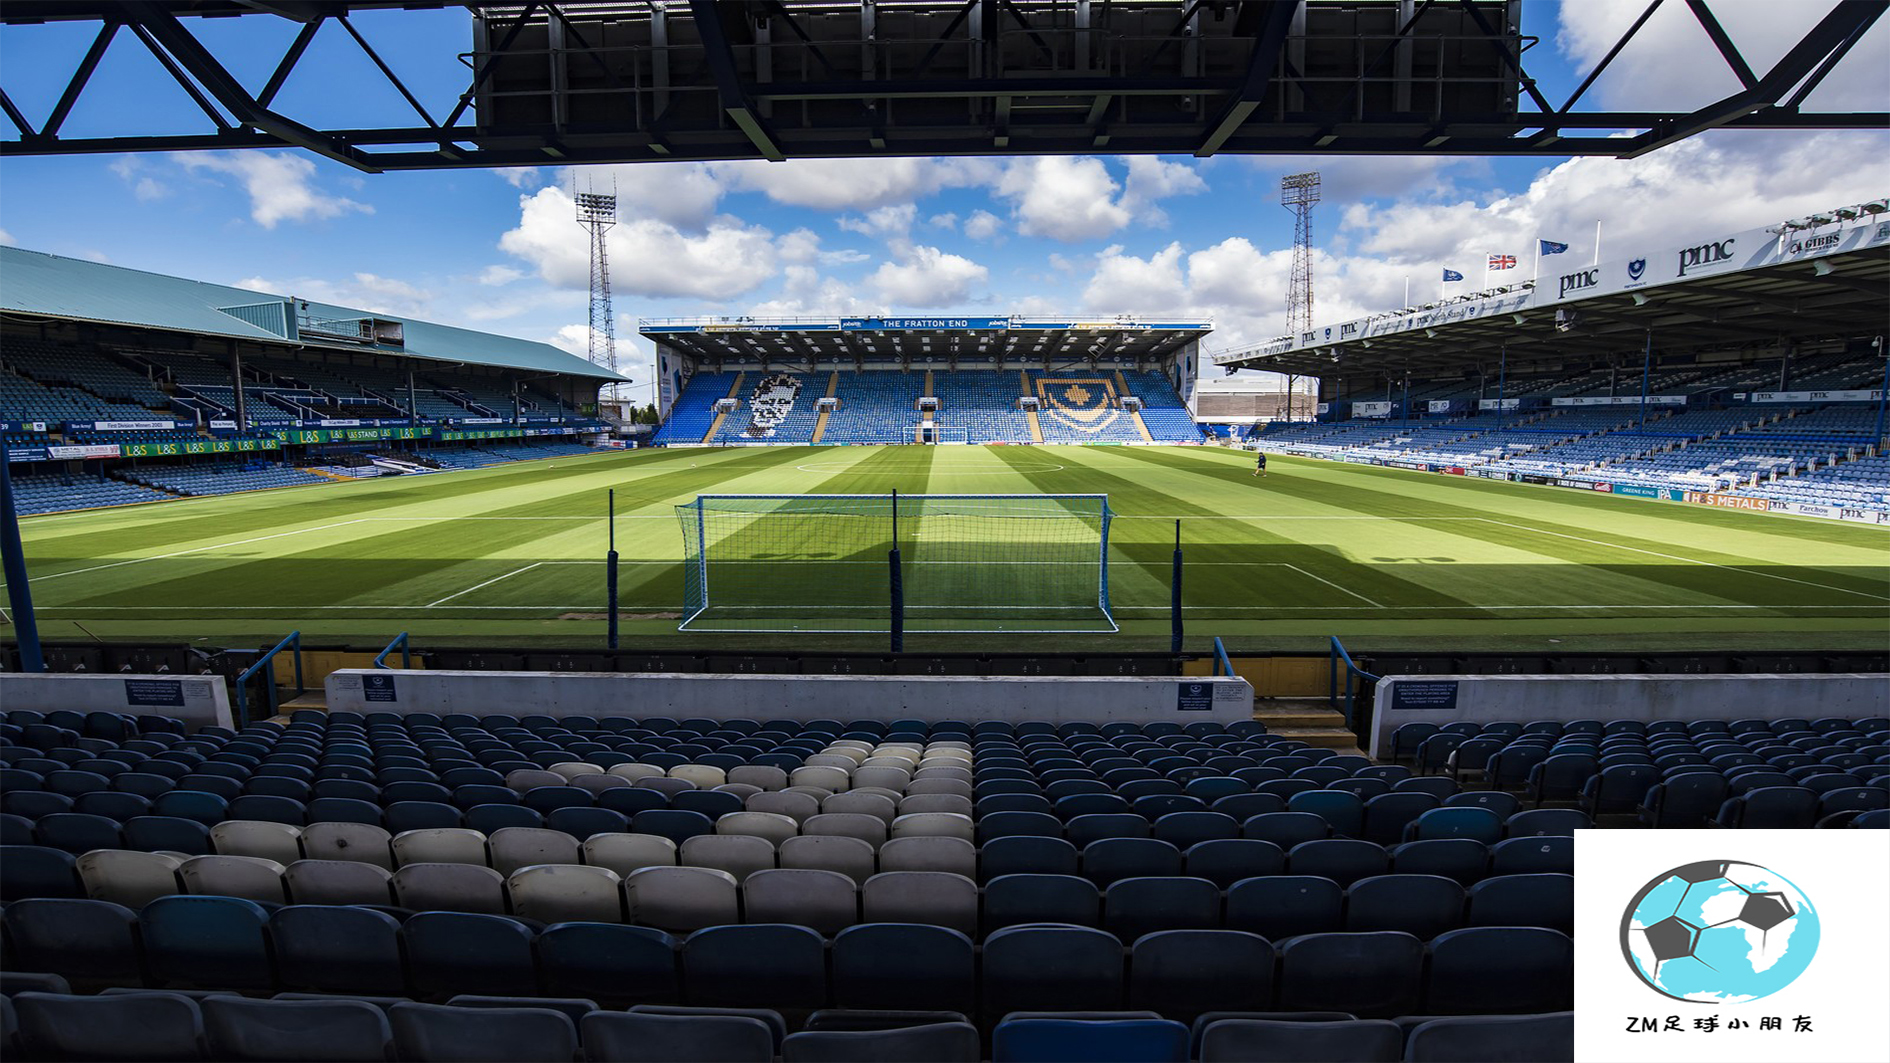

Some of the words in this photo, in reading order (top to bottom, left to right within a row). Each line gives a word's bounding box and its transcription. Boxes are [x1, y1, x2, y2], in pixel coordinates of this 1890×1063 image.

[1805, 234, 1840, 248] GIBBS
[1677, 238, 1735, 278] pmc
[1558, 268, 1599, 299] pmc
[1341, 322, 1358, 340] pmc
[1302, 331, 1316, 347] pmc
[1757, 393, 1774, 401] pmc
[1810, 392, 1830, 400] pmc
[300, 431, 319, 443] L&S
[330, 430, 343, 438] L&S
[400, 428, 414, 439] L&S
[158, 444, 176, 454] L&S
[186, 443, 205, 453] L&S
[213, 442, 230, 452] L&S
[238, 441, 254, 450] L&S
[262, 440, 276, 449] L&S
[126, 446, 147, 456] L&S
[1658, 489, 1672, 499] IPA
[1692, 494, 1714, 505] H&S
[1718, 496, 1766, 511] METALS
[1768, 500, 1790, 511] pmc
[1799, 505, 1828, 514] Parchow
[1840, 508, 1866, 519] pmc
